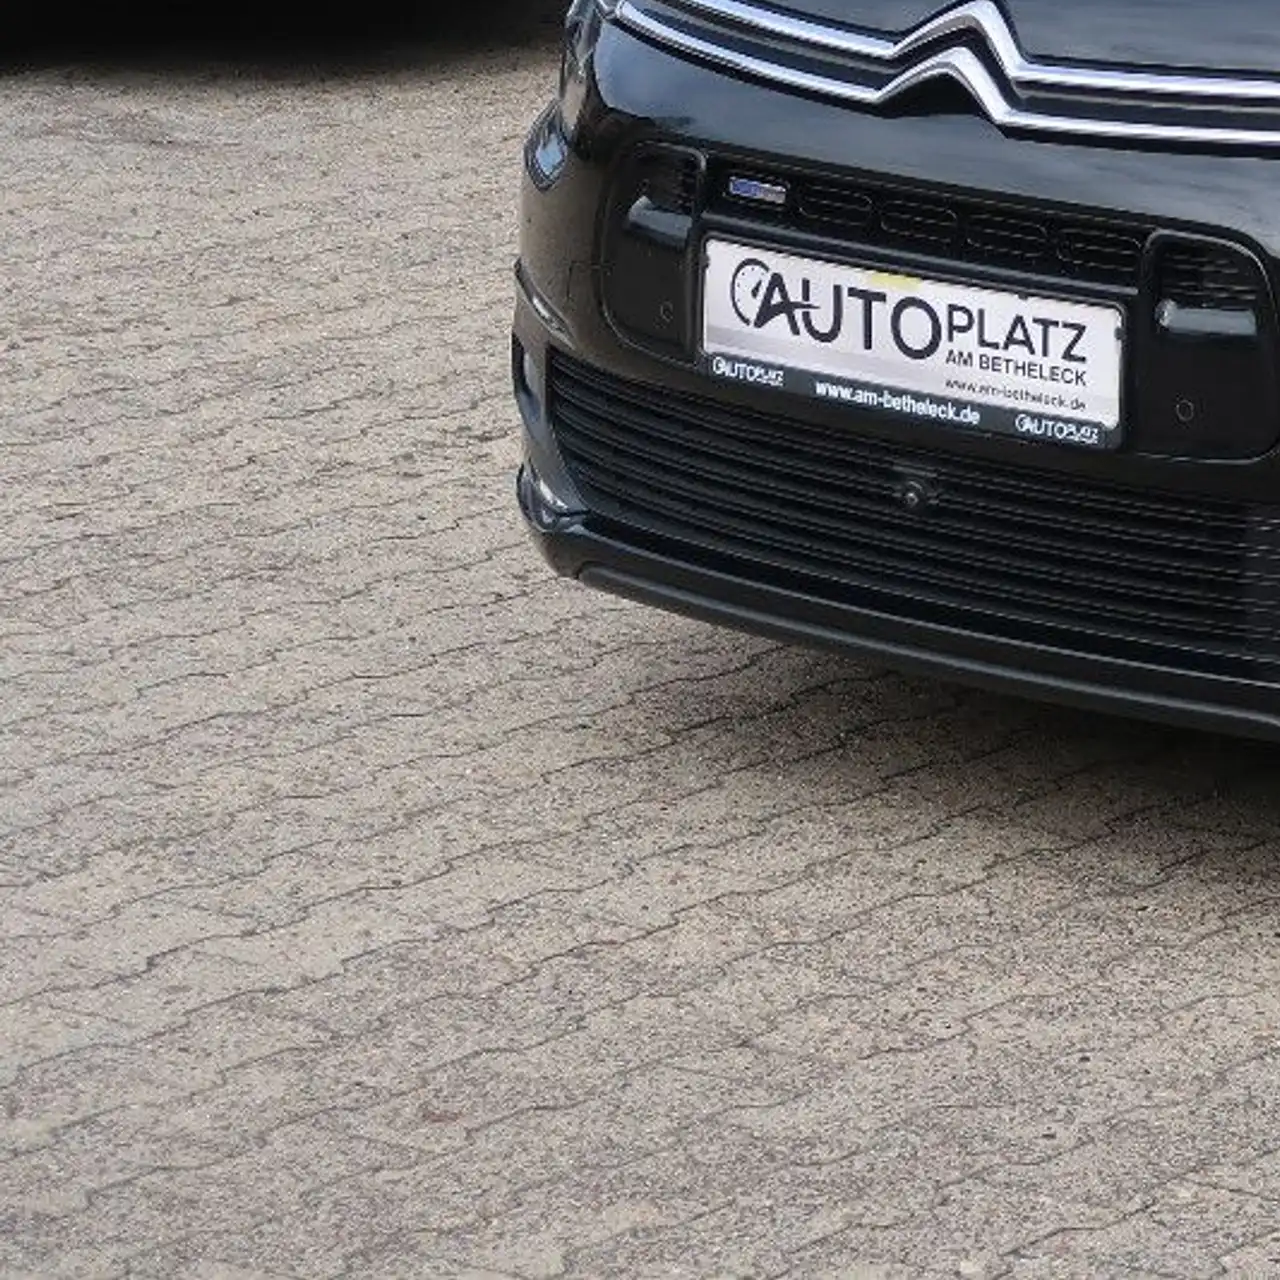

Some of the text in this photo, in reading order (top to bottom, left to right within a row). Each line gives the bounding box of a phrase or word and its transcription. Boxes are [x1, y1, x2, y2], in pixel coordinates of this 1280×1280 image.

[753, 272, 1087, 361] AUTOPLATZ
[944, 348, 1088, 388] AM BETHELECK
[815, 380, 982, 424] www.am-betheleck.de
